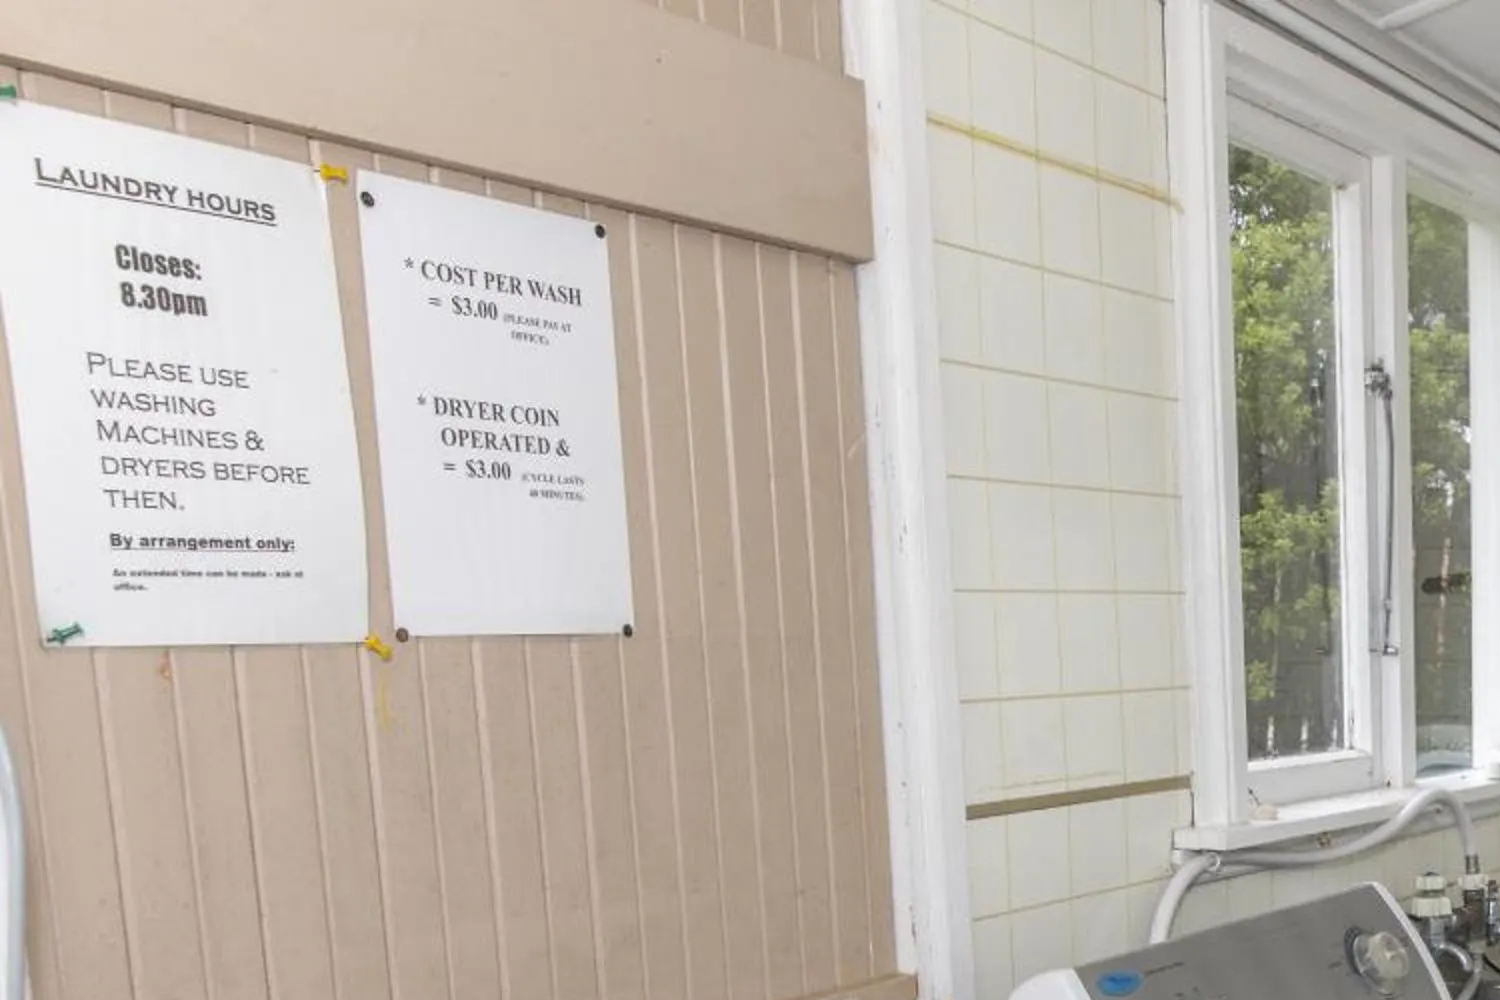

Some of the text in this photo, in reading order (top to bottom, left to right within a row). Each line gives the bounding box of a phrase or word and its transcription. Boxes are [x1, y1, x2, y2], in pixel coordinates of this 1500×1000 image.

[34, 157, 277, 222] LAUNDRY HOURS
[115, 244, 202, 280] Closes:
[421, 260, 583, 306] COST PER WASH
[120, 281, 208, 317] 8.30pm
[451, 295, 498, 320] $3.00
[86, 351, 250, 389] PLEASE USE
[90, 388, 217, 417] WASHING
[432, 396, 561, 427] DRYER COIN
[96, 419, 266, 452] MACHINES &
[440, 427, 572, 458] OPERATED &
[100, 455, 312, 486] DRYERS BEFORE
[465, 458, 512, 481] $3.00
[103, 488, 187, 511] THEN.
[109, 533, 296, 552] By arrangement only:
[130, 568, 178, 578] extended
[180, 569, 203, 578] time
[206, 570, 224, 578] can
